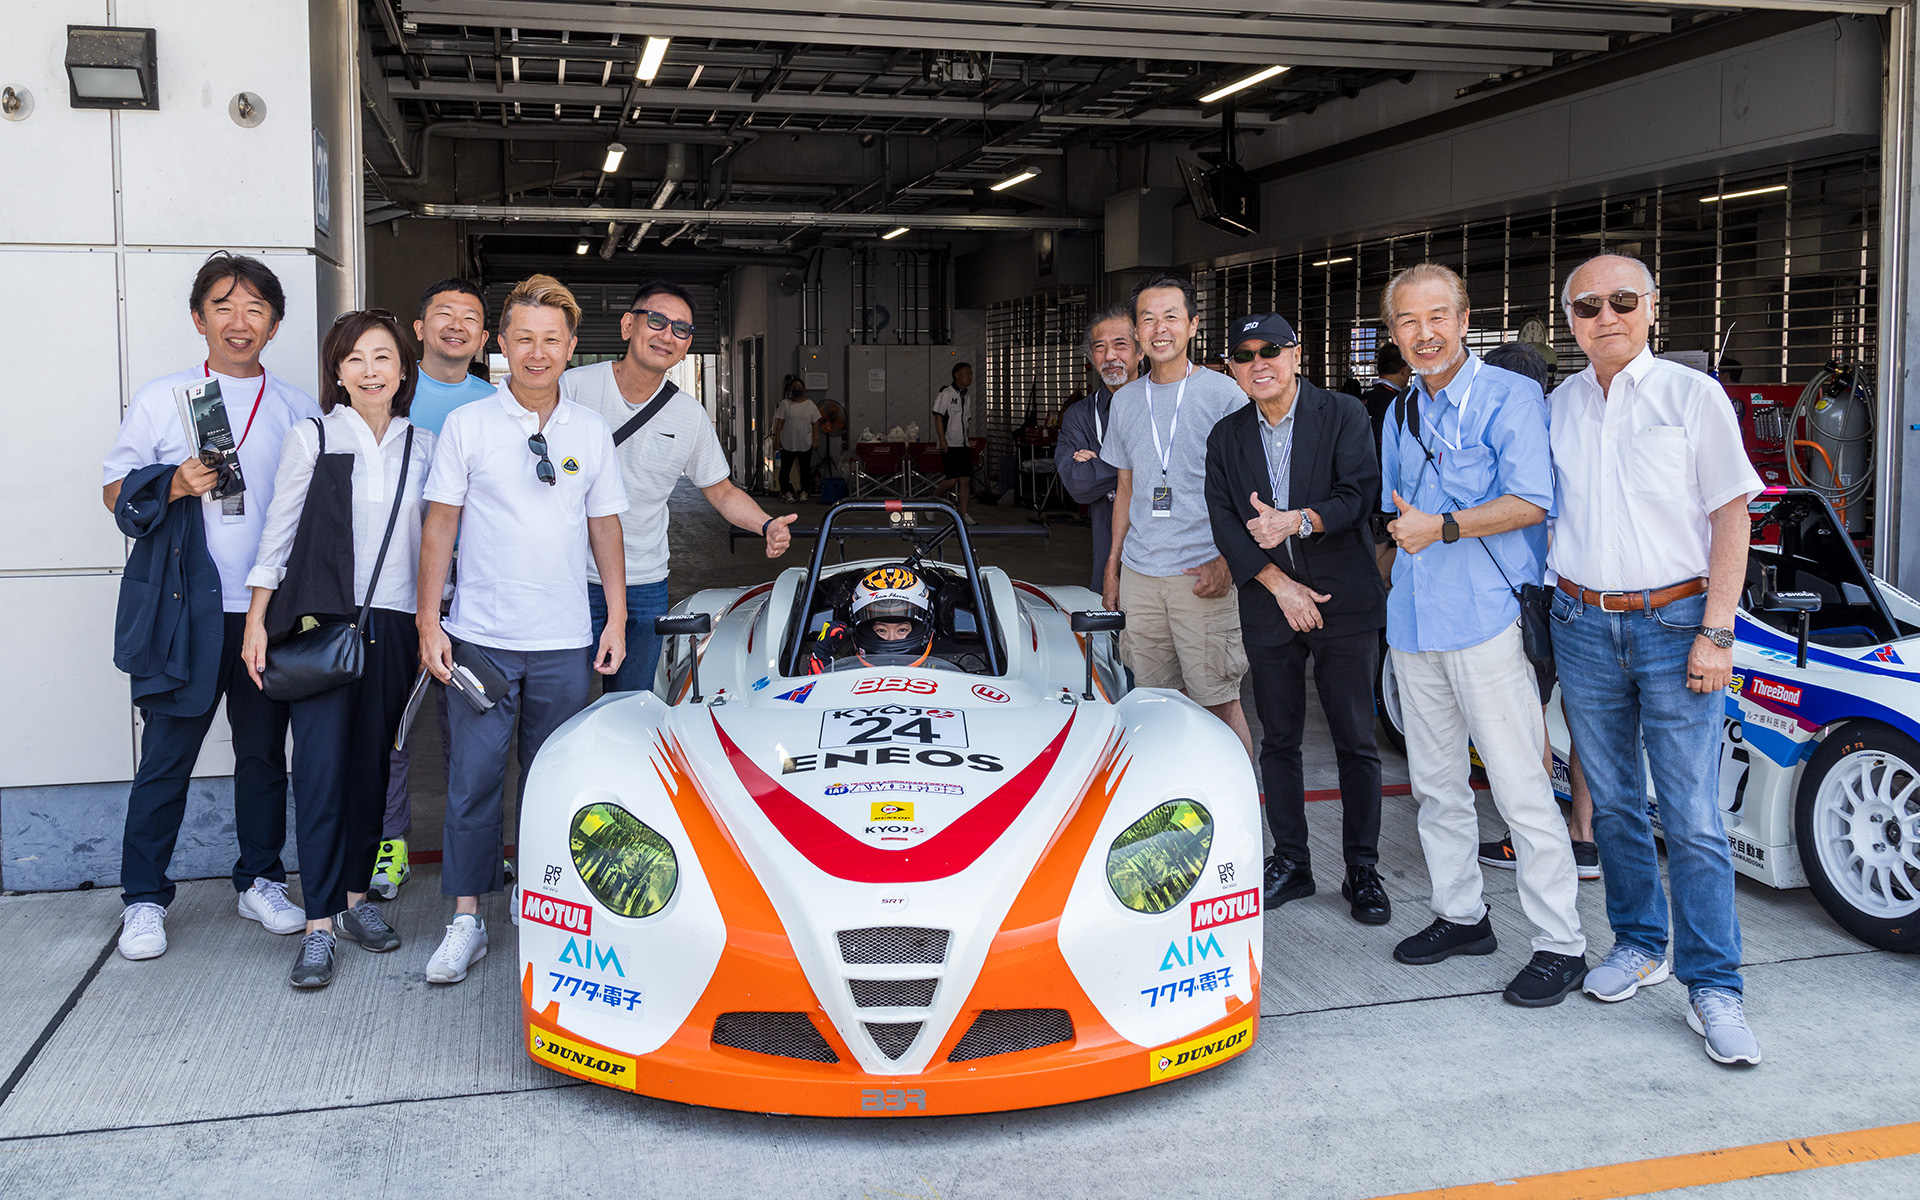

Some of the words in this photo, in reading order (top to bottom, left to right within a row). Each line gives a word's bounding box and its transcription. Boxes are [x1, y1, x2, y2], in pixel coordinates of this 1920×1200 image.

[851, 676, 939, 695] BBS
[1753, 679, 1801, 705] ThreeBond
[846, 716, 942, 745] 24
[781, 747, 1005, 775] ENEOS
[523, 894, 588, 932] MOTUL
[1194, 892, 1258, 928] MOTUL
[558, 935, 626, 978] AIM
[1158, 931, 1225, 972] AIM
[549, 971, 642, 1012] フクダ電子
[1140, 966, 1234, 1008] フクダ電子
[546, 1041, 627, 1076] DUNLOP
[1174, 1029, 1248, 1067] DUNLOP
